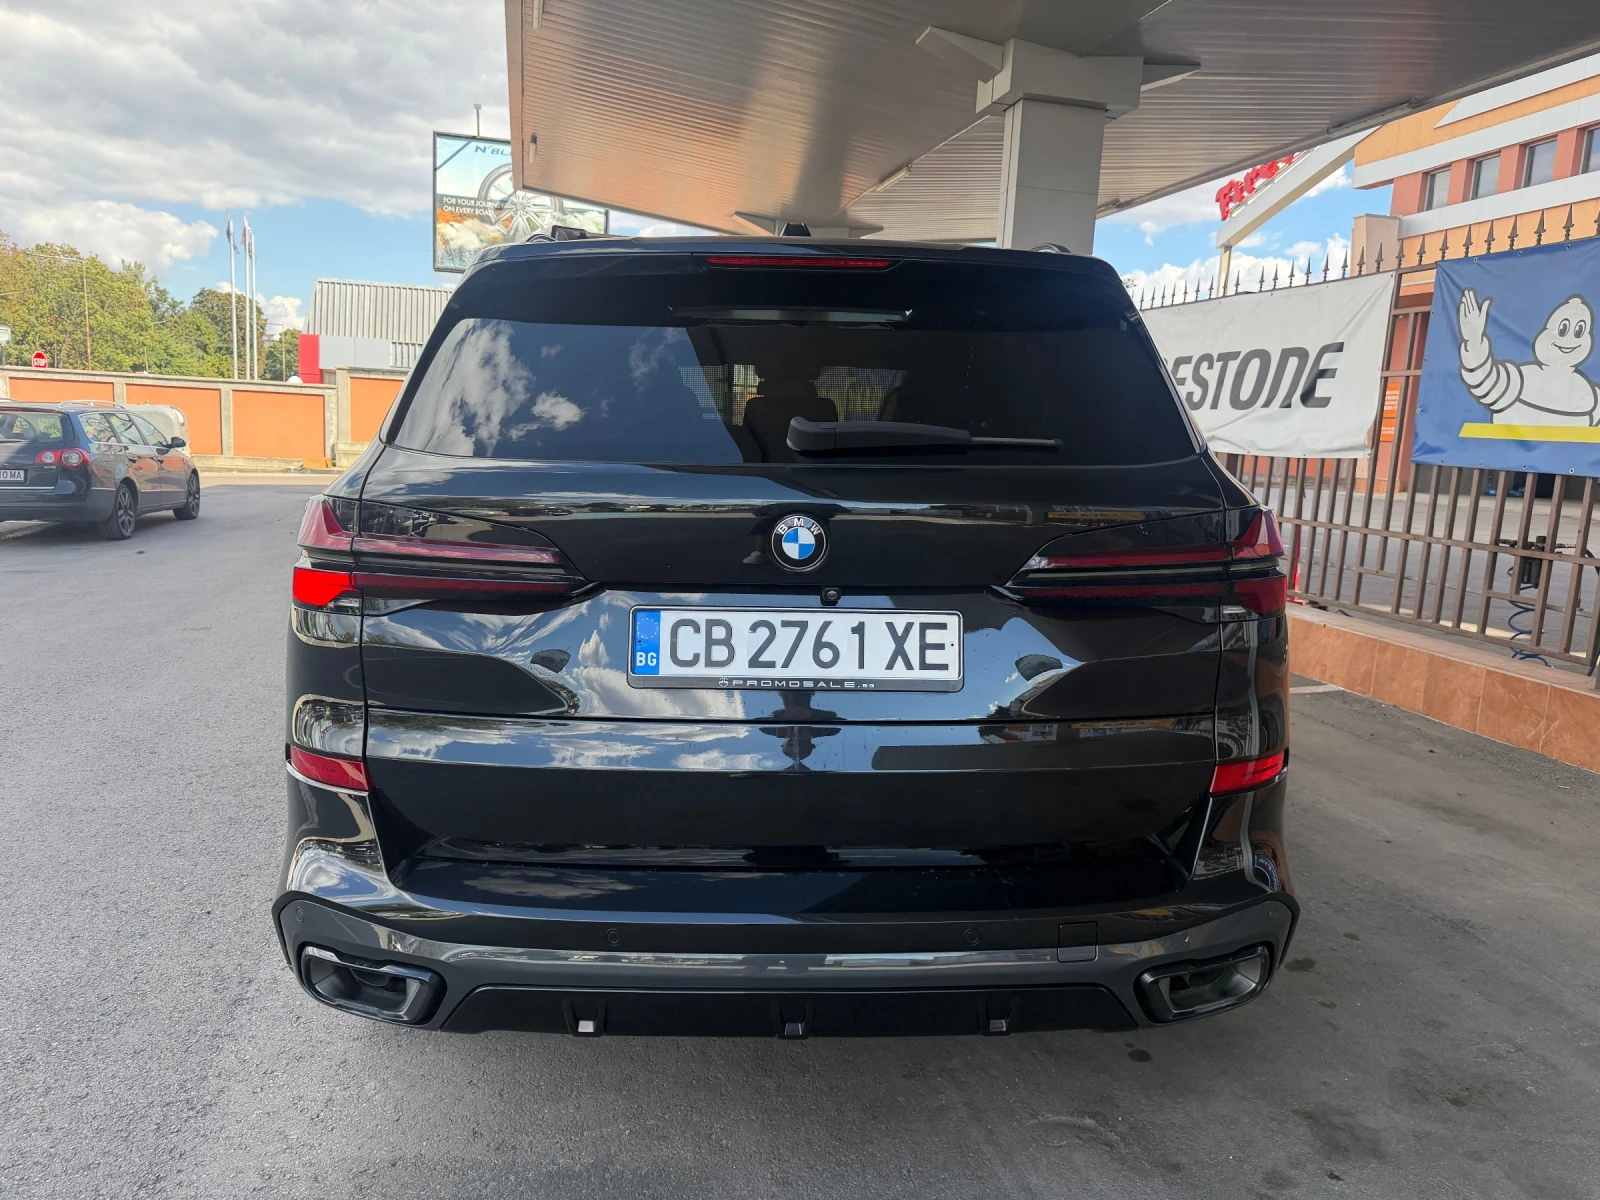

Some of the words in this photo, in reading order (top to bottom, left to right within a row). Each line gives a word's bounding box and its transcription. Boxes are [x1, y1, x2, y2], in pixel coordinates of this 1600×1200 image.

[474, 145, 511, 156] N'BL
[458, 198, 475, 206] YOUR
[33, 358, 46, 366] STOP
[1164, 341, 1344, 410] ESTONE
[10, 471, 22, 480] MA
[778, 518, 821, 535] BMW
[669, 618, 735, 668] CB
[747, 619, 865, 670] 2761
[884, 621, 949, 671] XE
[636, 652, 657, 666] BG
